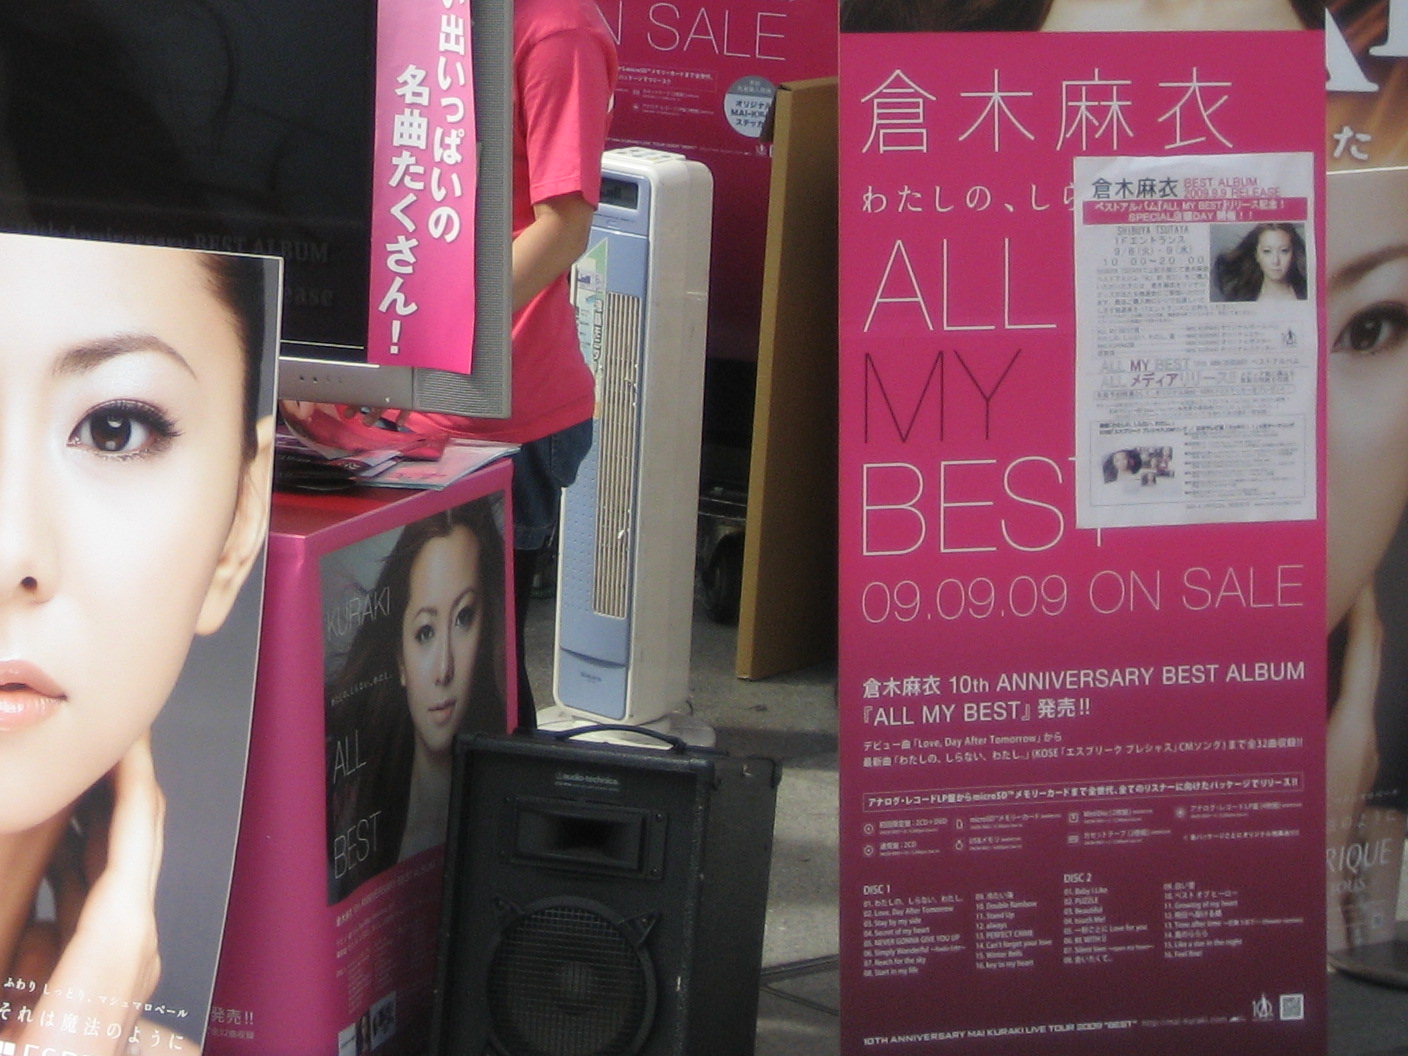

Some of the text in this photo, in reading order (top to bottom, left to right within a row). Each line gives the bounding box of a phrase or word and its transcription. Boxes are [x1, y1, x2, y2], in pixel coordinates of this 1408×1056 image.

[647, 2, 787, 61] SALE
[861, 67, 1234, 154] 倉木麻衣
[378, 64, 432, 355] 名曲たくさん!
[1092, 177, 1258, 200] 倉木麻衣 BEST ALBUM
[1231, 187, 1281, 198] RELEASE
[864, 238, 1057, 333] ALL
[1130, 359, 1149, 372] MY
[865, 349, 1021, 444] MY
[327, 586, 390, 641] KURAKI
[861, 564, 1305, 624] 09.09.09 ON SALE
[863, 661, 1305, 699] 倉木麻衣 10th ANNIVERSARY BEST ALBUM
[922, 704, 956, 724] MY
[333, 728, 367, 784] ALL
[334, 810, 383, 880] BEST
[863, 884, 885, 895] DISC
[1064, 874, 1084, 883] DISC
[3, 978, 36, 992] ふわり
